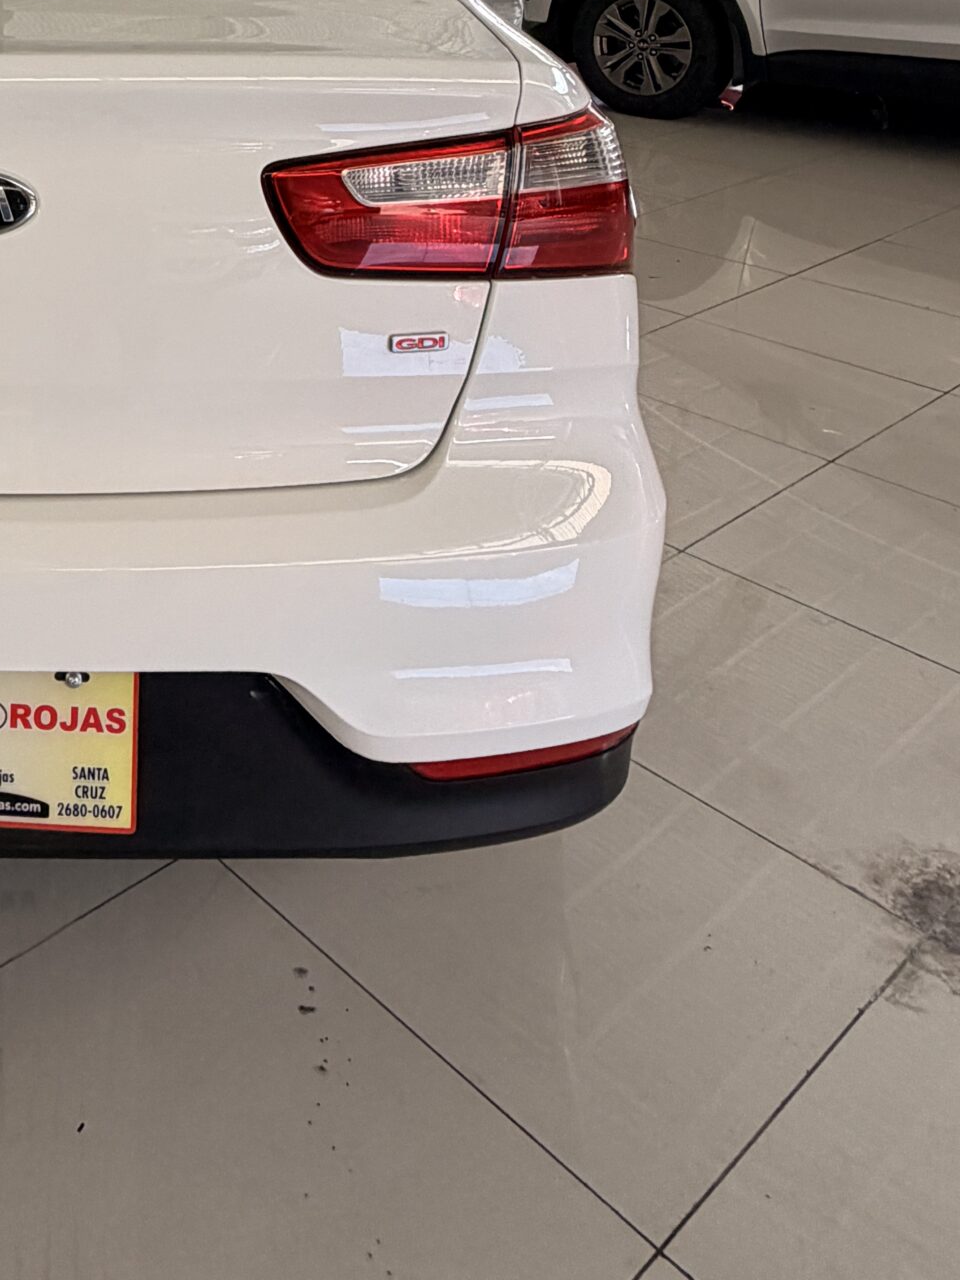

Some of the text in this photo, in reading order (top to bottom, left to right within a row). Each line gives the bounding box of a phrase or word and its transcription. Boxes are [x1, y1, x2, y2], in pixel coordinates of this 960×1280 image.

[395, 336, 445, 350] GDI
[9, 703, 127, 734] ROJAS
[72, 766, 110, 782] SANTA
[74, 785, 107, 800] CRUZ
[57, 802, 123, 819] 2680-0607
